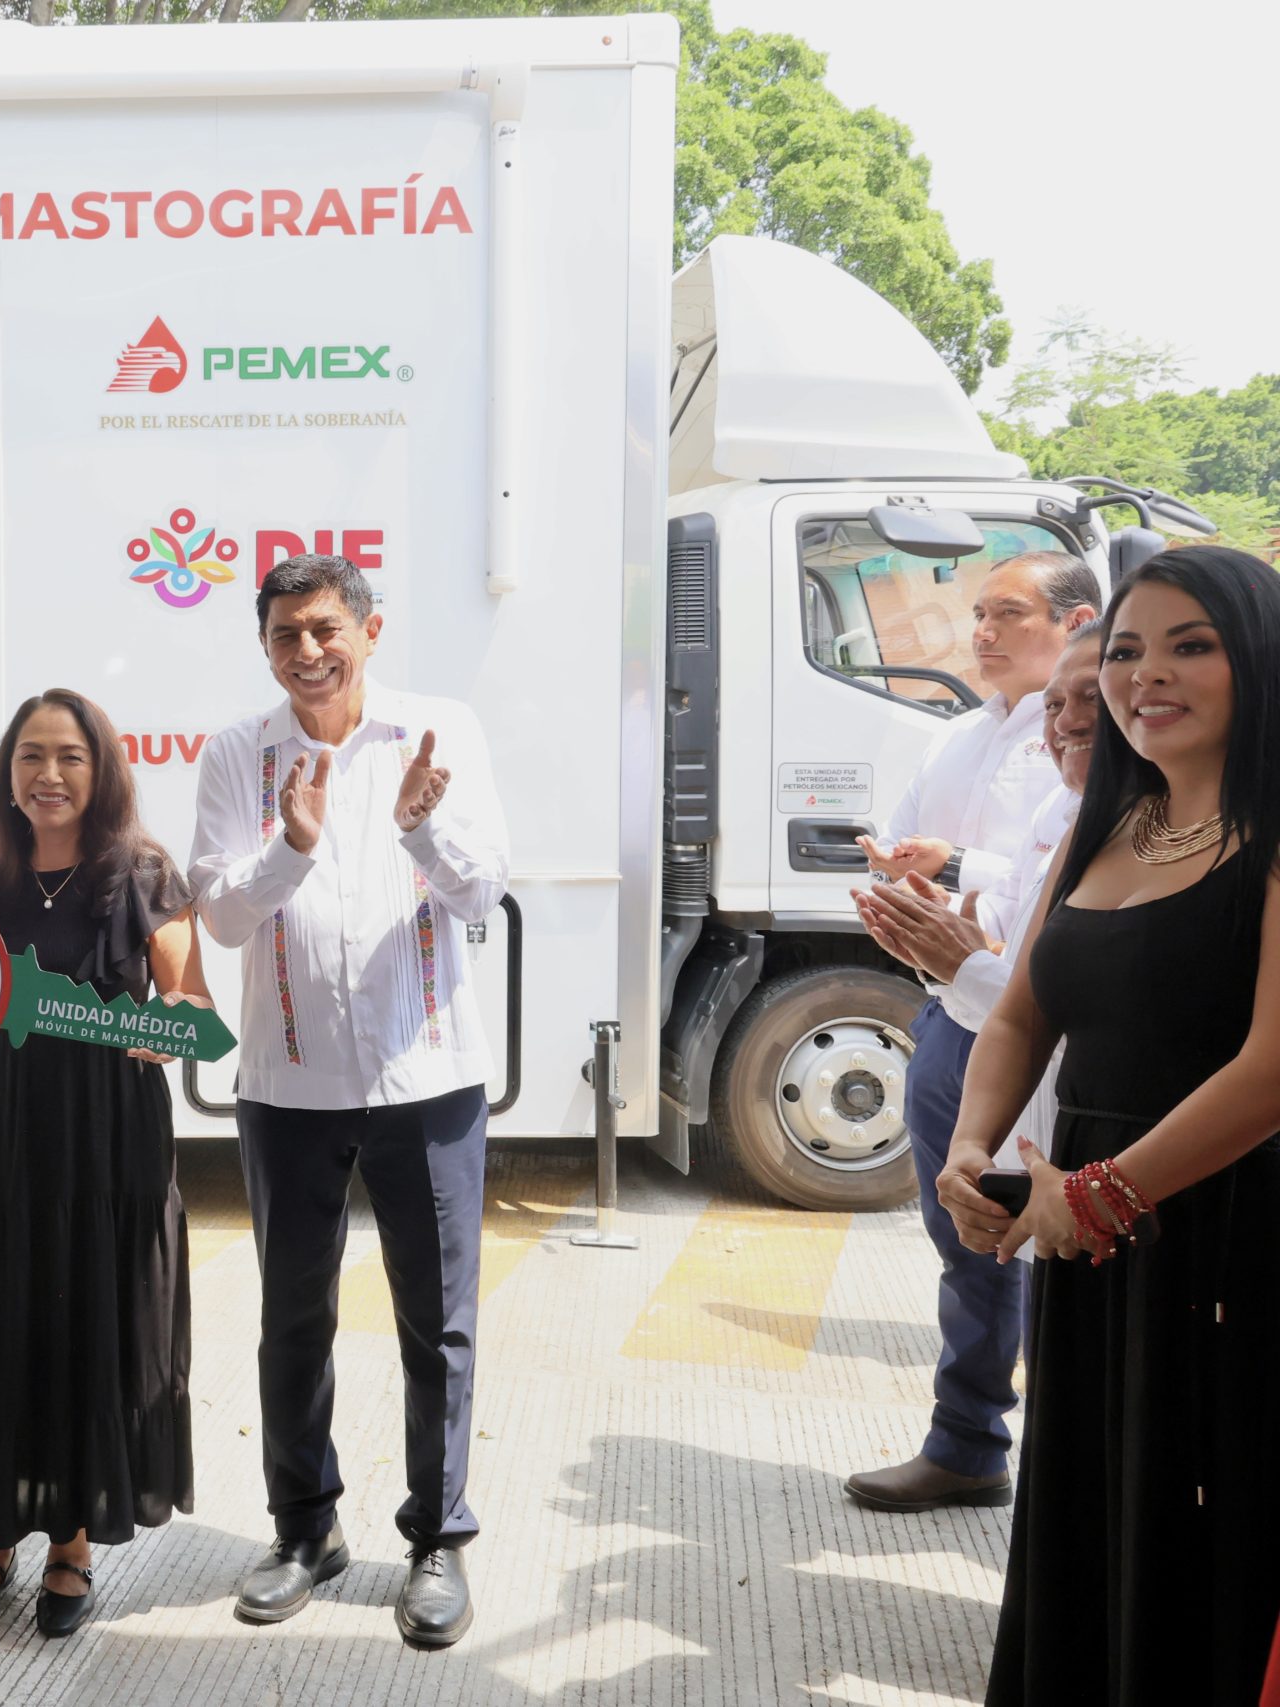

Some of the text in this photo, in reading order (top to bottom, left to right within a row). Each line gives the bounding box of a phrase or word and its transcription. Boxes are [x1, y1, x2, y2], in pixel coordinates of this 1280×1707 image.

[203, 345, 390, 380] PEMEX
[99, 409, 407, 429] POR EL RESCATE DE LA SOBERANÍA
[34, 1018, 195, 1056] MÓVIL DE MASTOGRAFÍA
[37, 998, 198, 1042] UNIDAD MÉDICA
